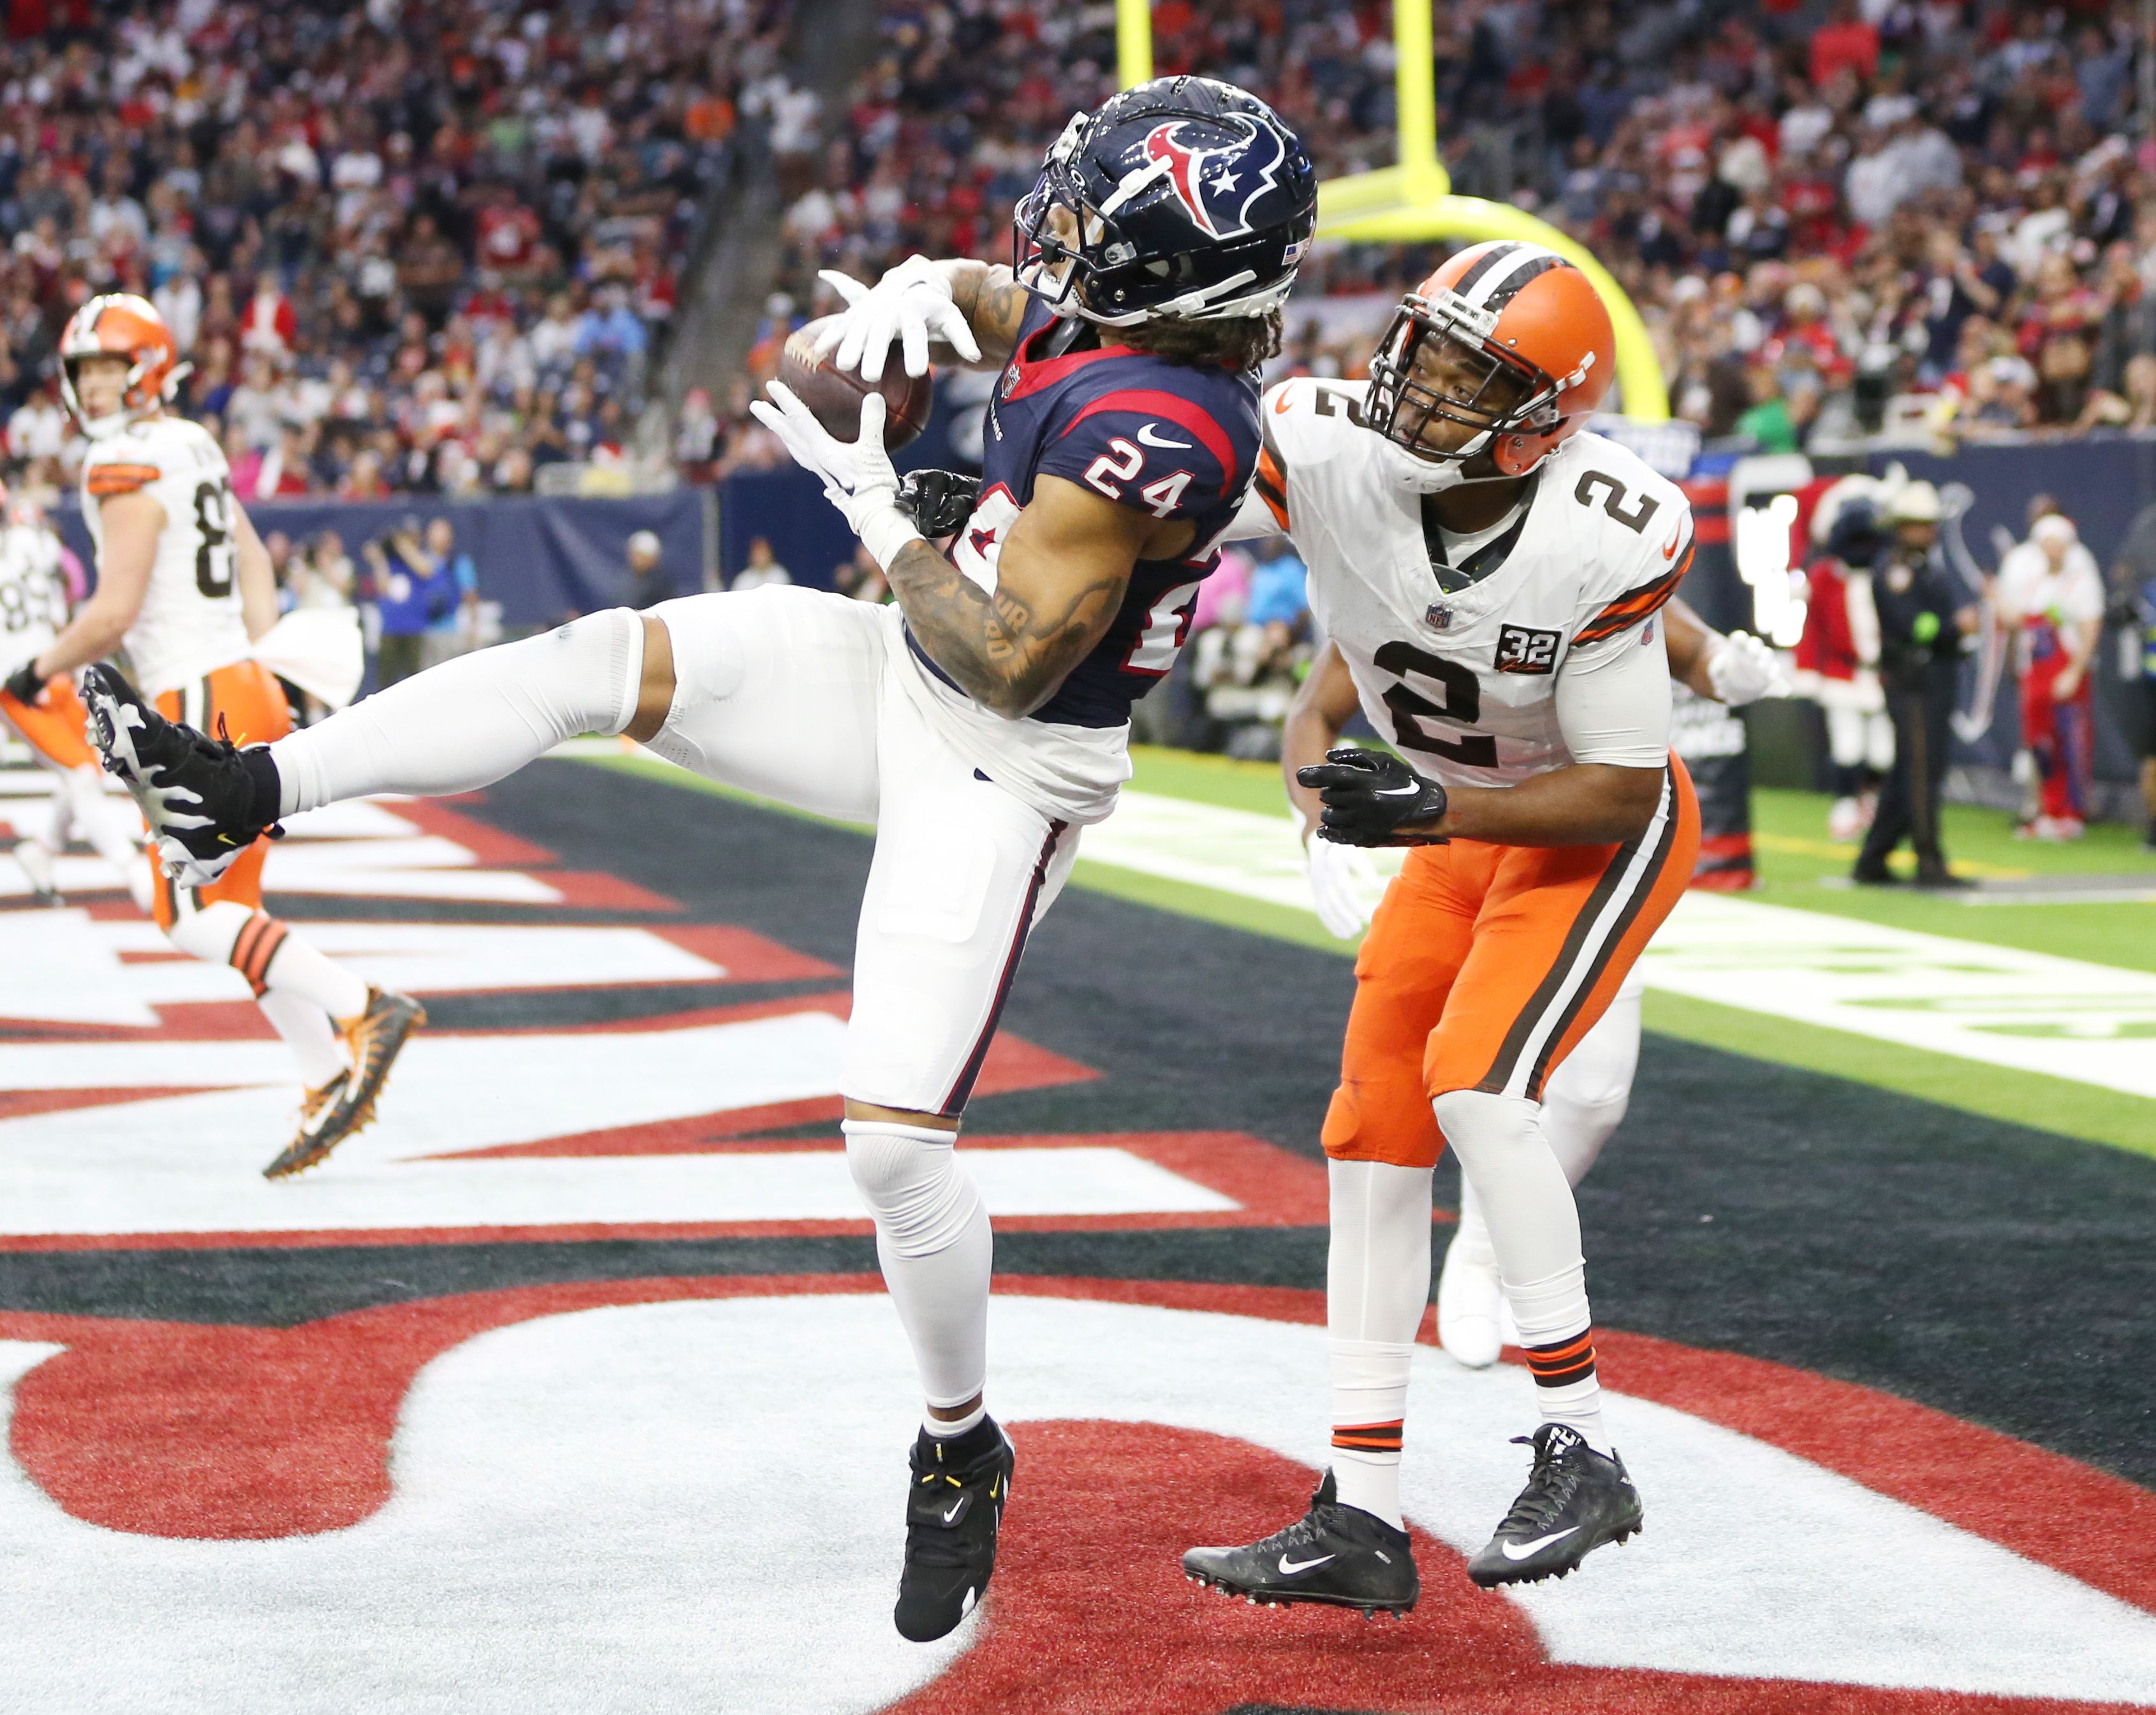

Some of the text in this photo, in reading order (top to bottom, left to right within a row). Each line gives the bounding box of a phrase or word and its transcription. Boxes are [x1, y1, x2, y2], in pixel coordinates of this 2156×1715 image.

[1082, 437, 1195, 519] 24
[1574, 469, 1661, 535] 2
[1500, 629, 1557, 665] 32
[1374, 640, 1499, 769] 2
